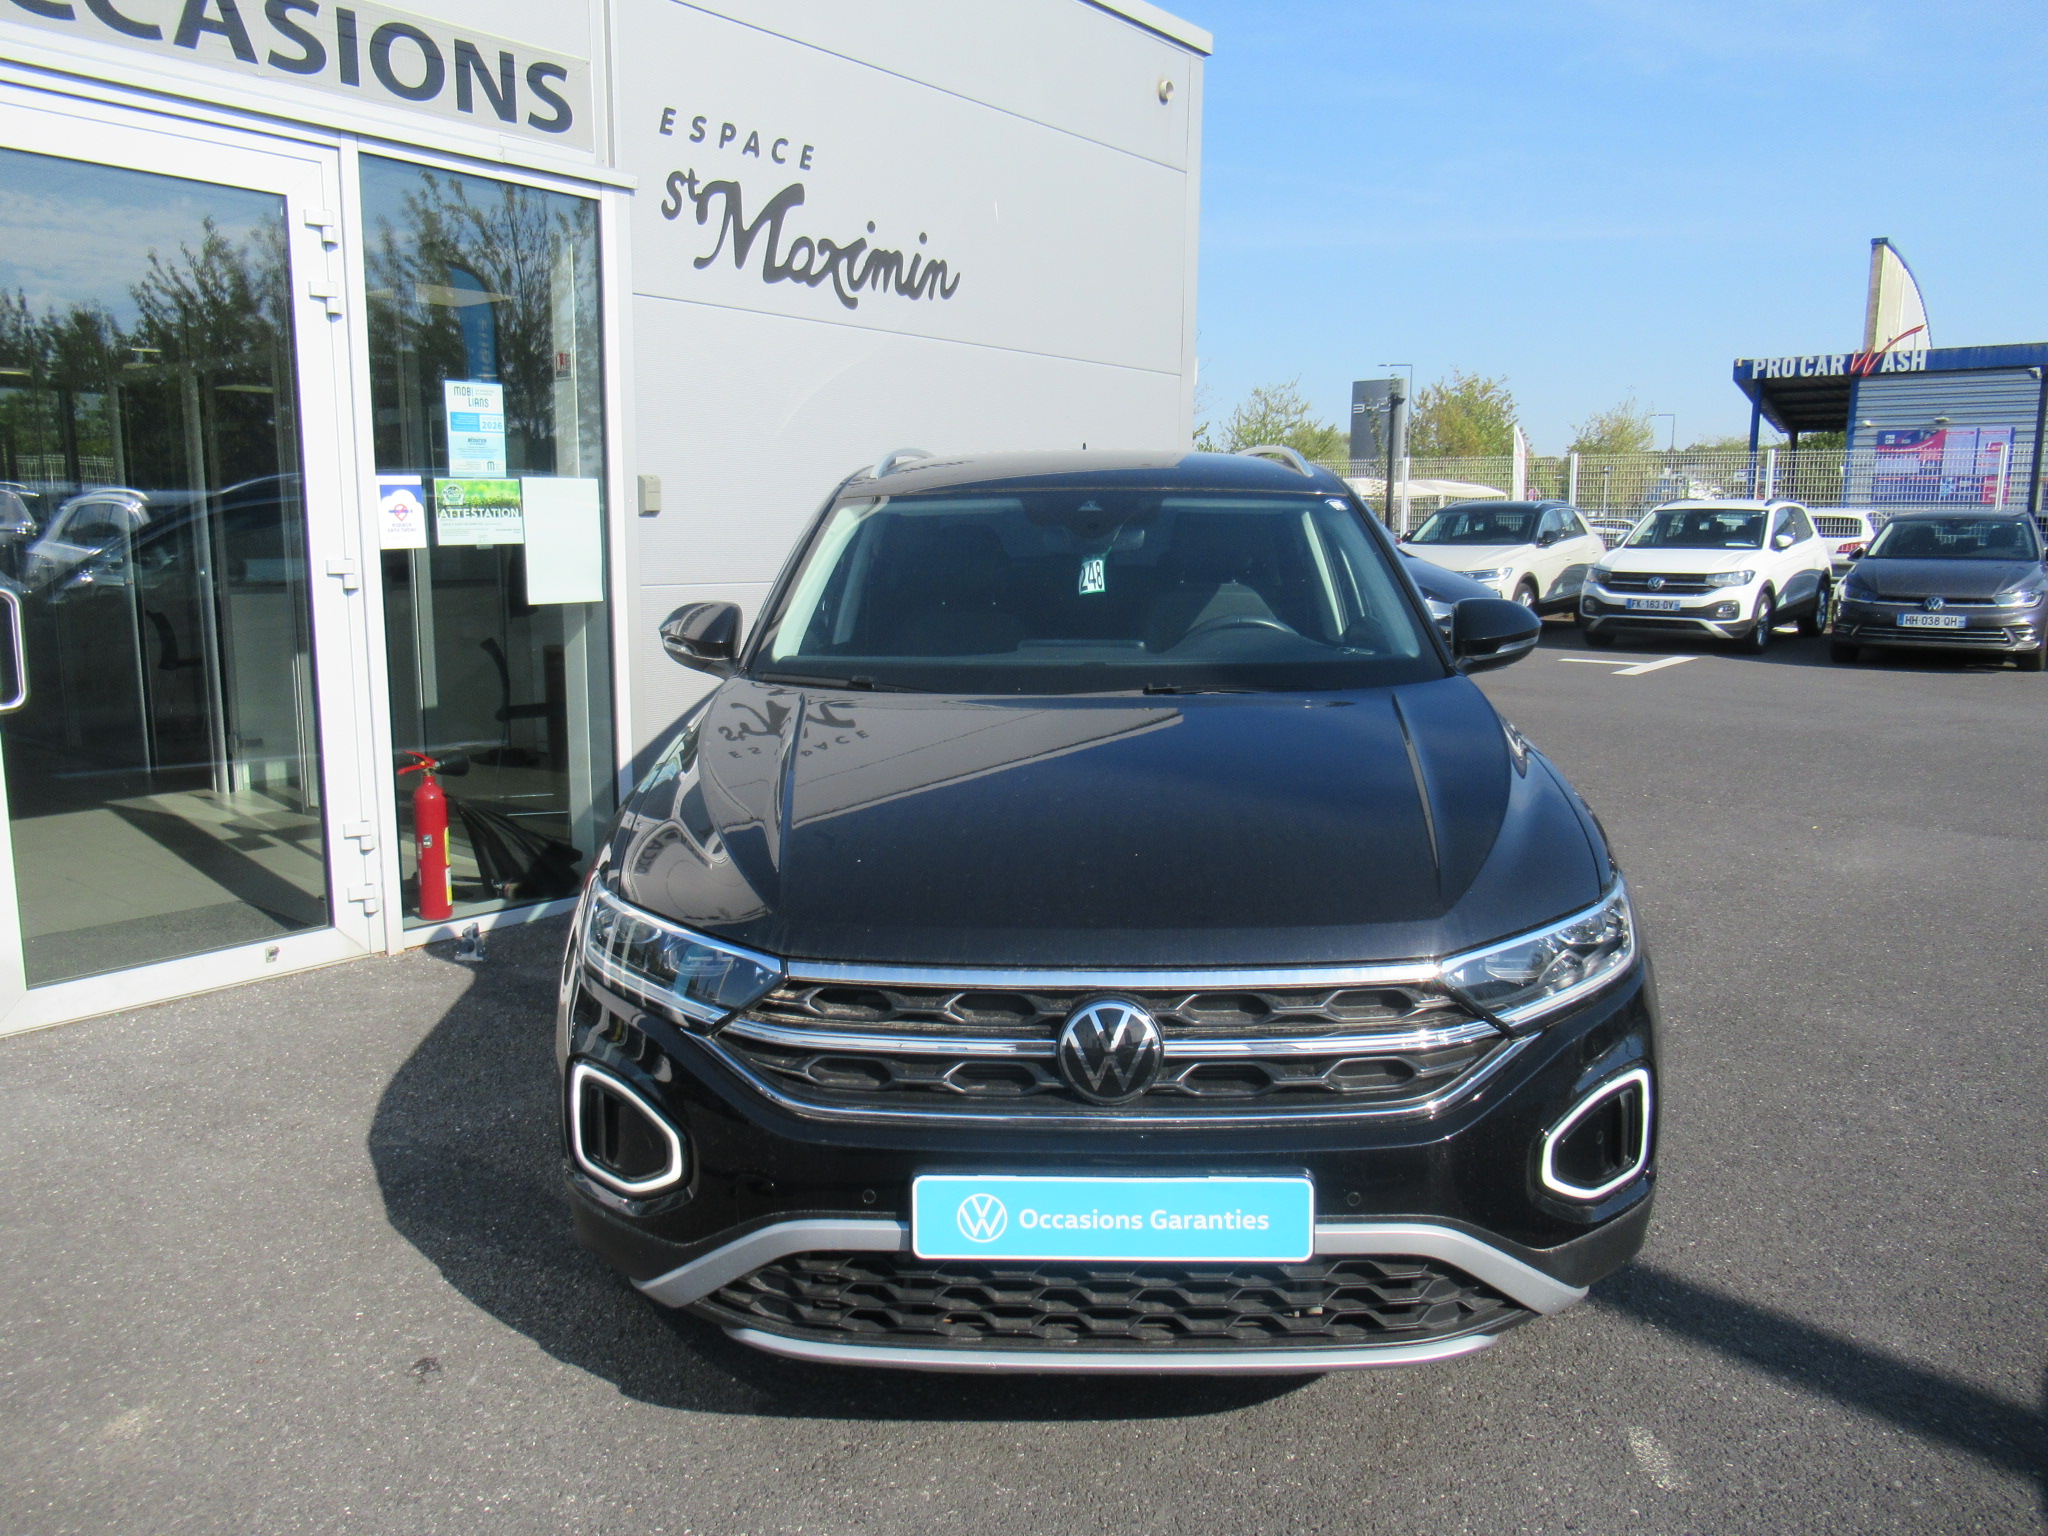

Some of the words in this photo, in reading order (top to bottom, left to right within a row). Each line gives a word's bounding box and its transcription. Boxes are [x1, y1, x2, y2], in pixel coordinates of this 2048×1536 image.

[8, 0, 573, 133] ASIONS
[659, 107, 815, 171] ESPACE
[693, 180, 961, 310] Maximin
[1752, 357, 1796, 379] PRO
[1800, 354, 1845, 377] CAR
[1850, 338, 1927, 377] WASH
[482, 421, 503, 430] 2026
[440, 508, 520, 518] ATTESTATION
[1080, 561, 1103, 592] 248
[1019, 1208, 1143, 1230] Occasions
[1149, 1209, 1270, 1231] Garanties
